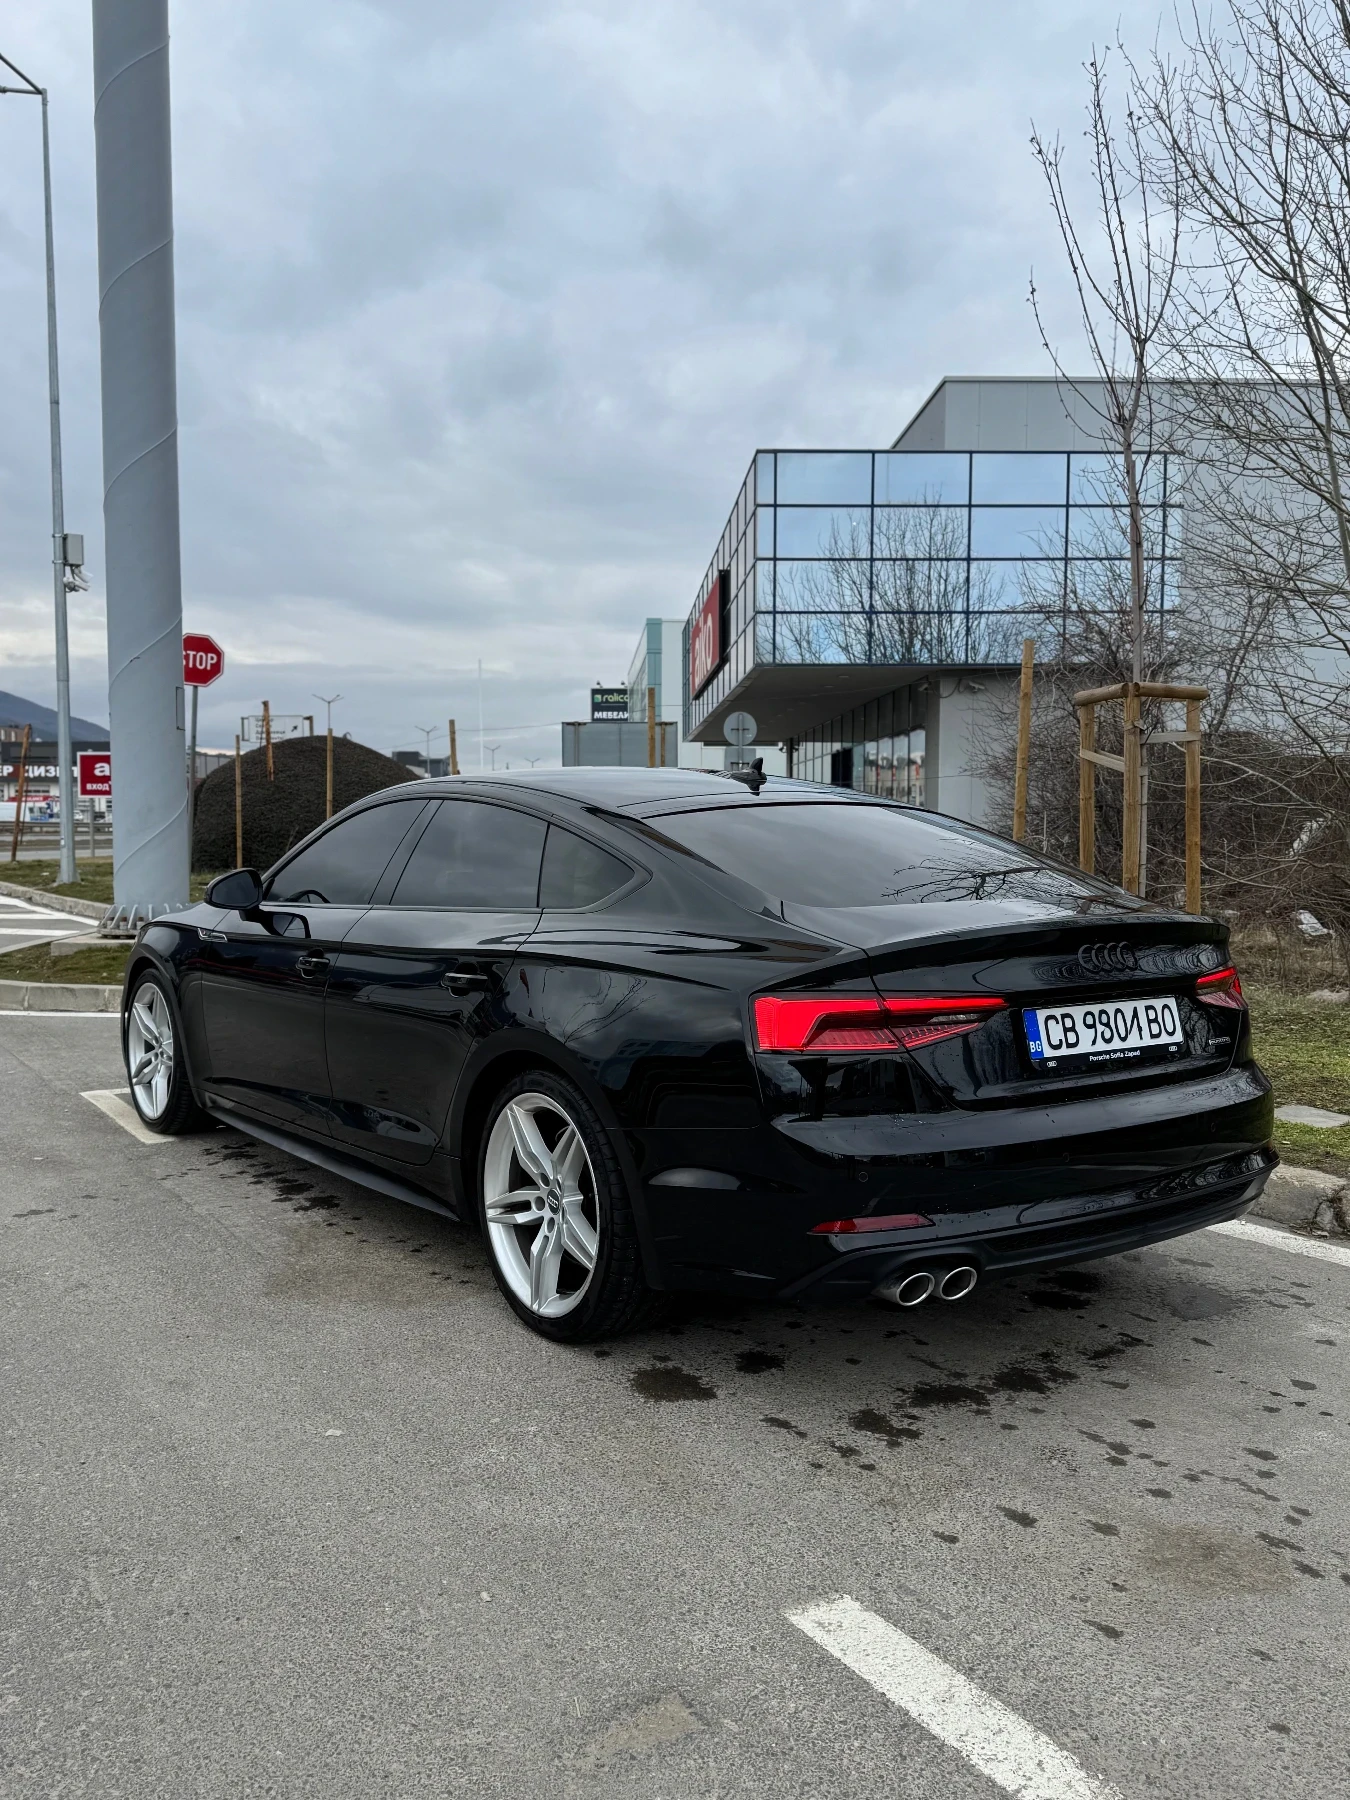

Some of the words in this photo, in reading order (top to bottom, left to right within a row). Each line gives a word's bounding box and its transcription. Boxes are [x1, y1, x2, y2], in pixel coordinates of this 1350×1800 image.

[1044, 1013, 1080, 1050] CB
[1029, 1040, 1042, 1053] BG
[1089, 1053, 1110, 1062] Porsche
